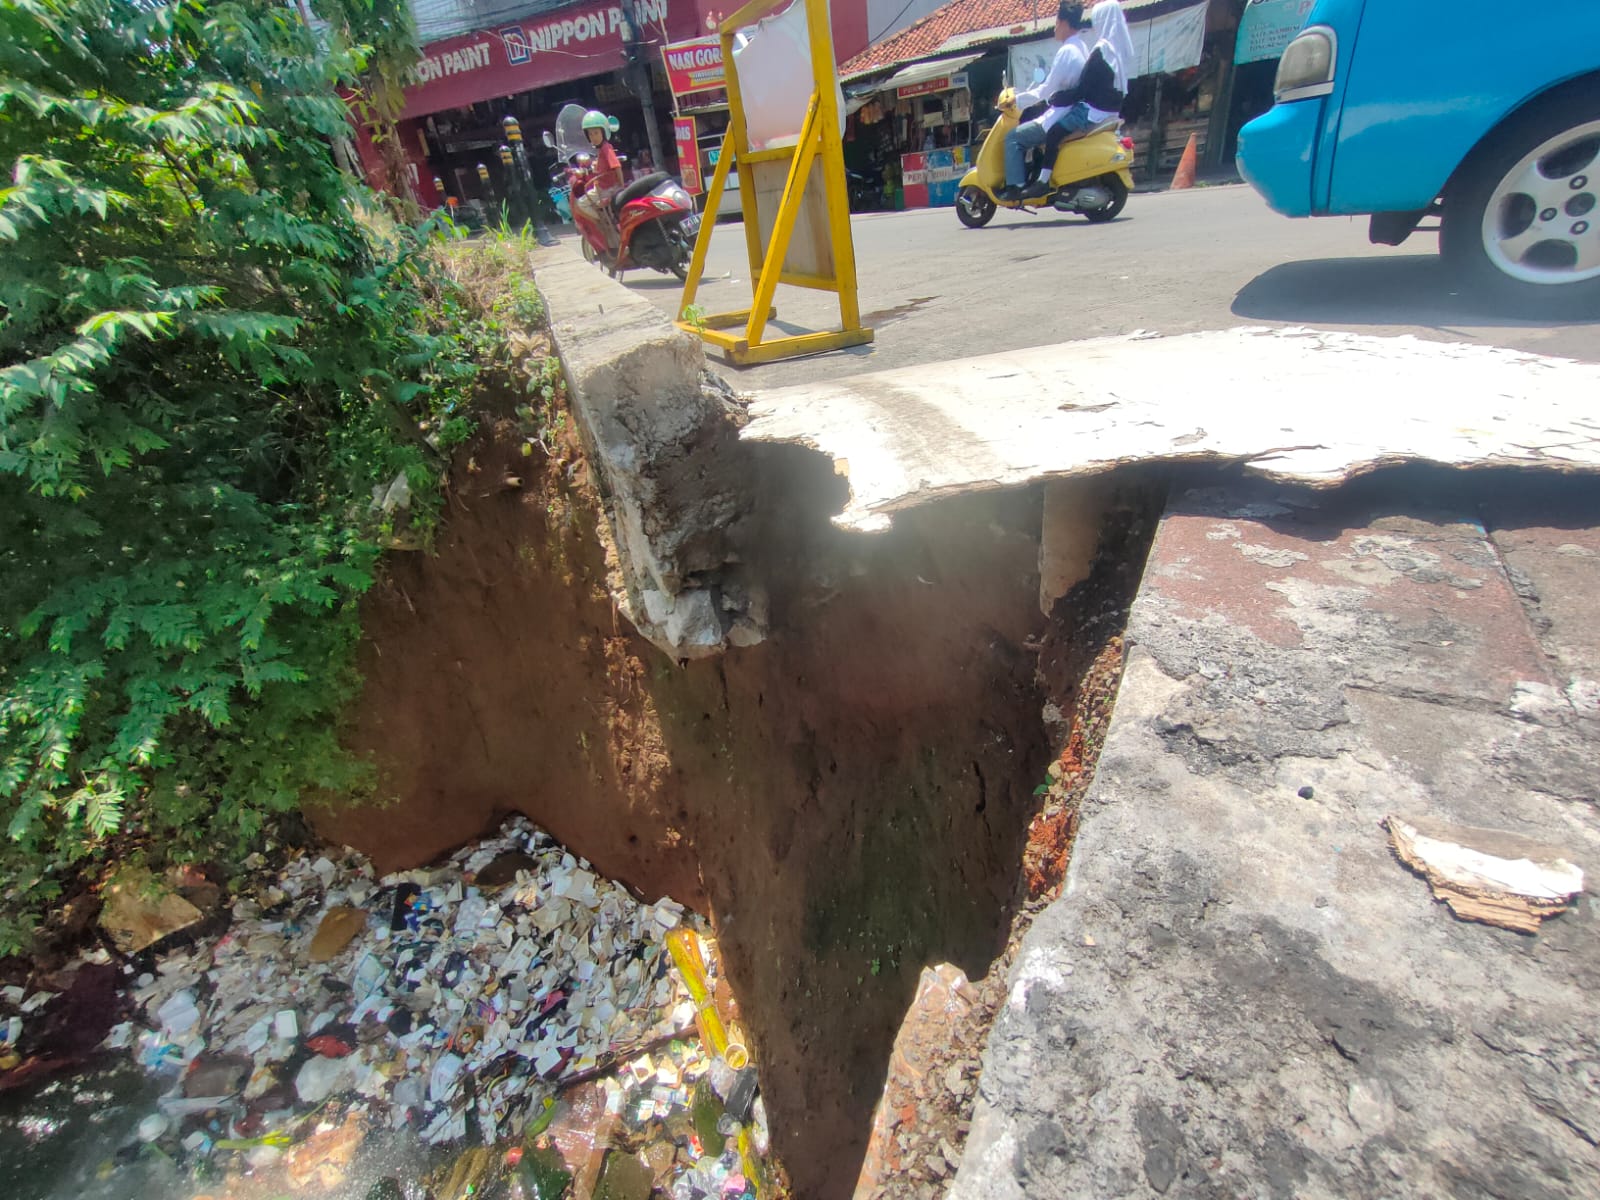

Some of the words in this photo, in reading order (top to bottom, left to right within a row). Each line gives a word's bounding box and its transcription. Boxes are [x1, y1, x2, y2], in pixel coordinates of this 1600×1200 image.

[529, 11, 606, 53] NIPPON
[441, 42, 490, 76] PAINT
[668, 51, 696, 71] NASI
[696, 47, 723, 66] GOR
